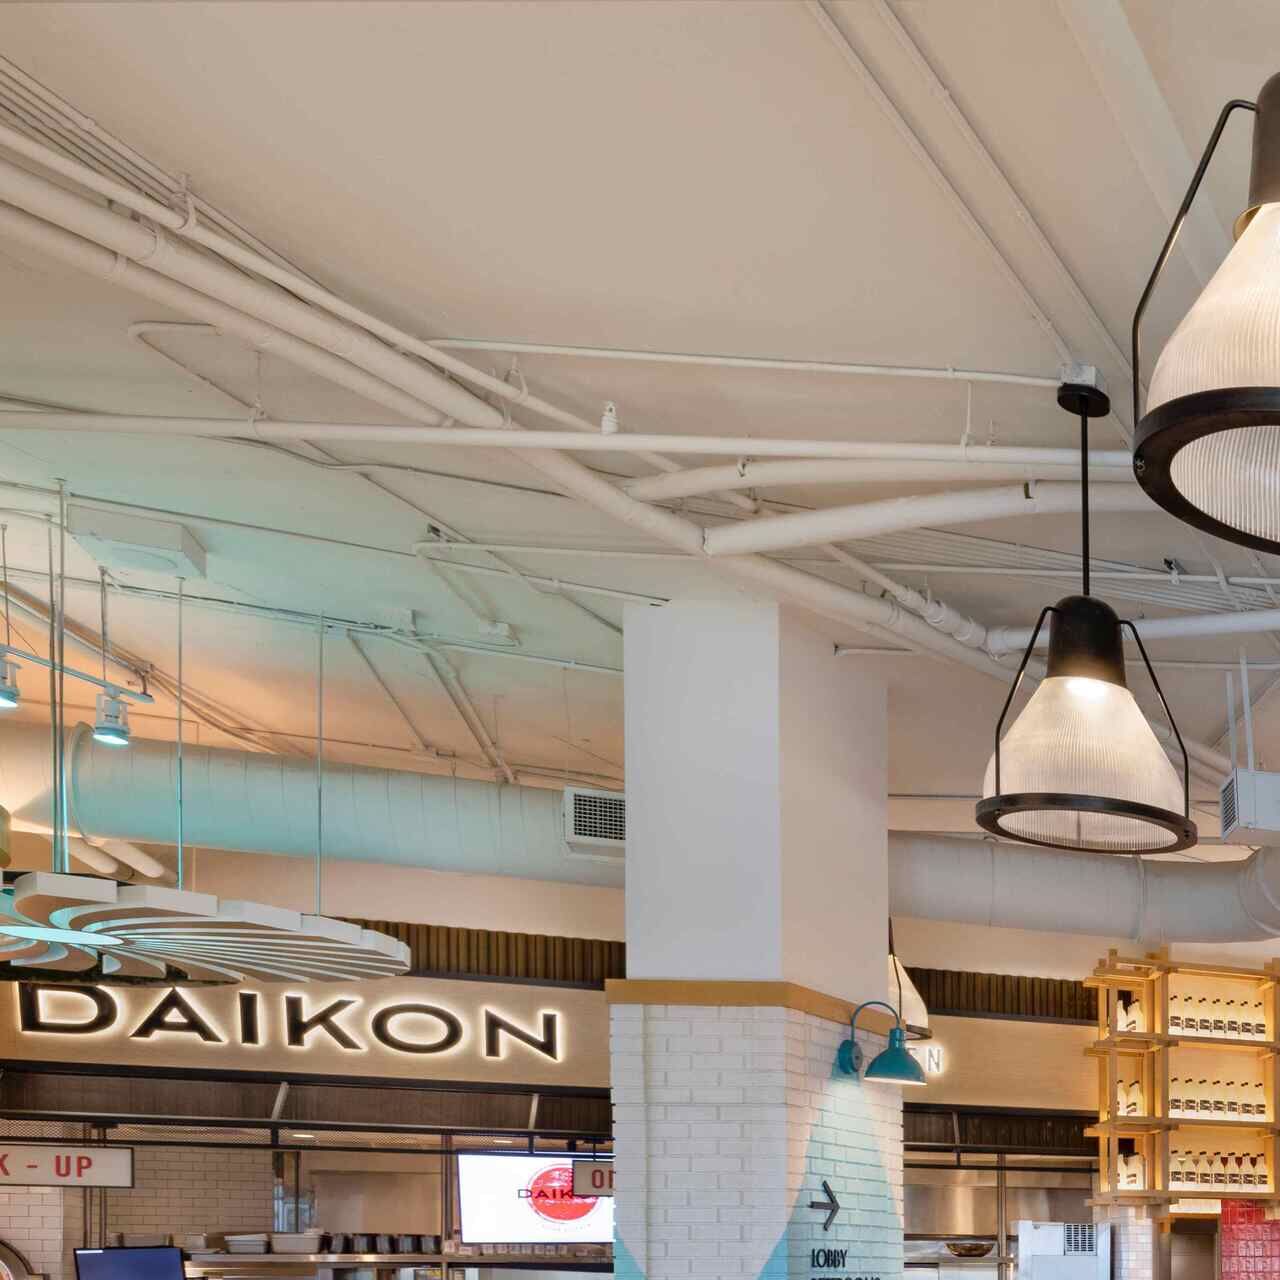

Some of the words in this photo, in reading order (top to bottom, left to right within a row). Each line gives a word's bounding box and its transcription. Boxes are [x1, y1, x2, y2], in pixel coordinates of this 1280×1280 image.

[18, 981, 558, 1060] DAIKON
[55, 1155, 93, 1177] UP
[811, 1248, 848, 1269] LOBBY
